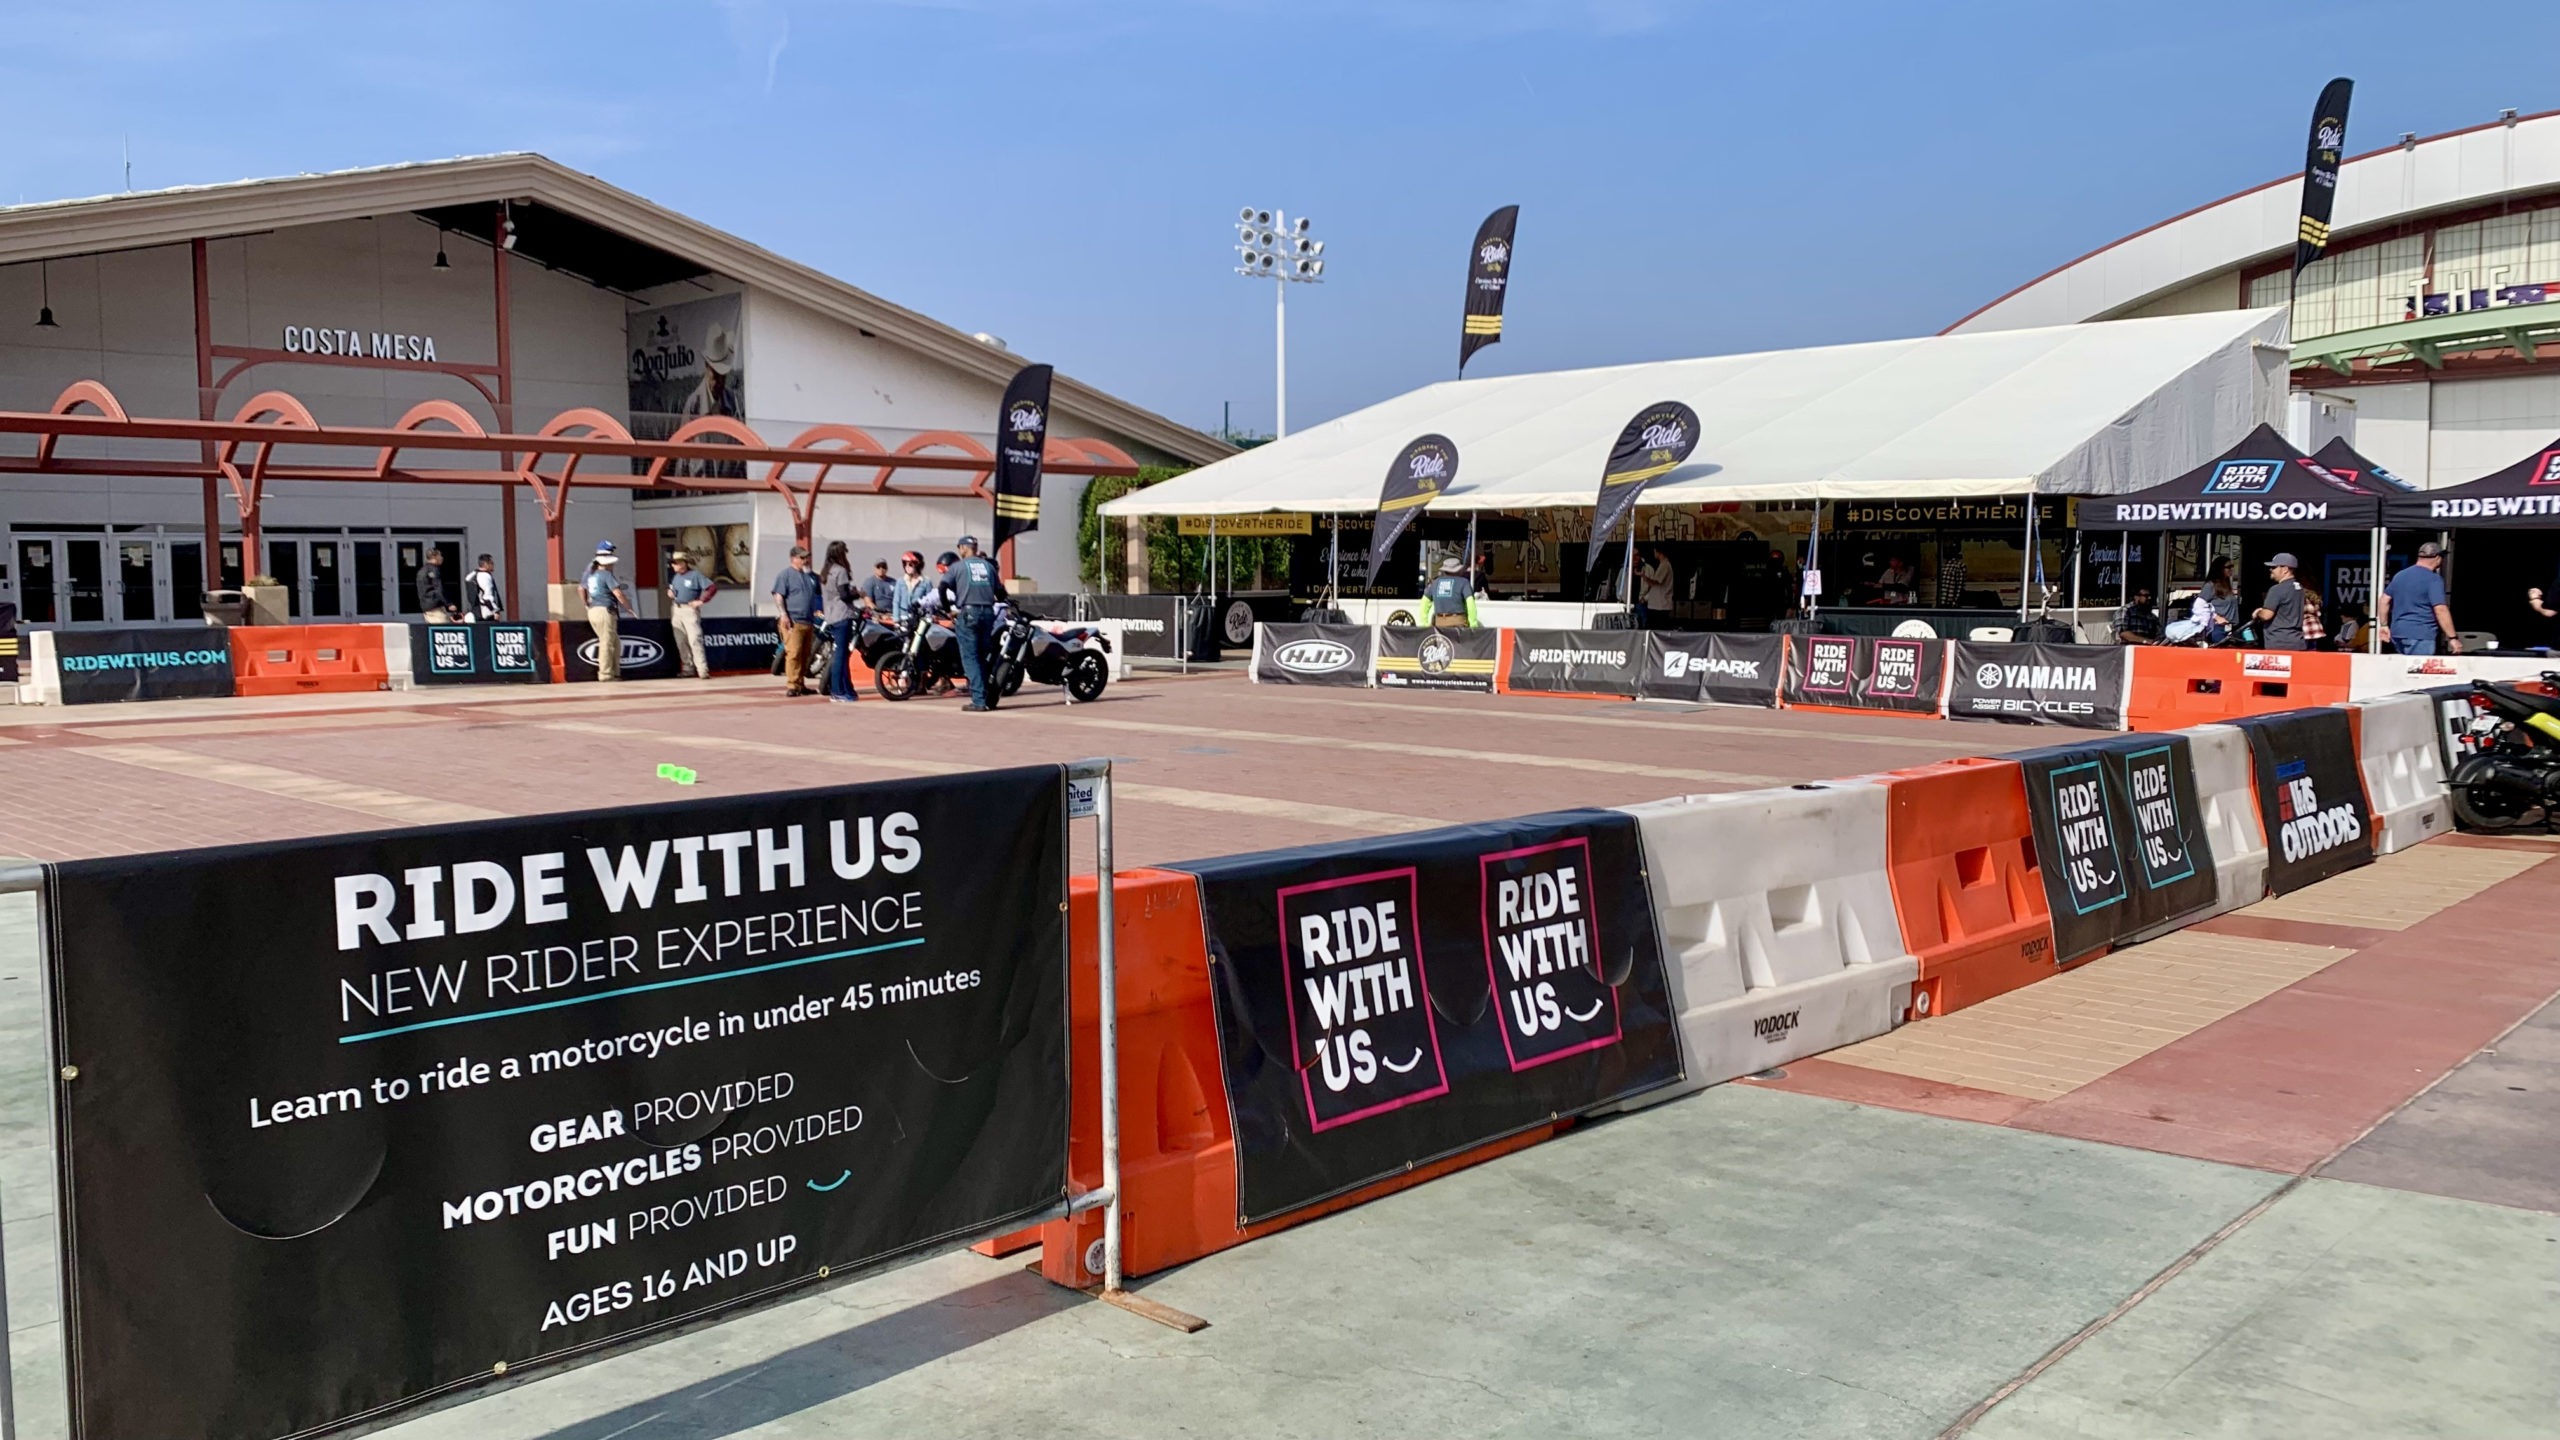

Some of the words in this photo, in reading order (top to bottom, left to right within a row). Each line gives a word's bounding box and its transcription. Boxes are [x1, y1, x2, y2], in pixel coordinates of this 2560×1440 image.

[1481, 243, 1508, 264] Ride
[2410, 265, 2509, 318] THE
[285, 325, 362, 357] COSTA
[372, 332, 436, 362] MESA
[1010, 409, 1041, 430] Ride
[1641, 421, 1682, 449] Ride
[1410, 453, 1444, 478] Ride
[2224, 465, 2269, 475] RIDE
[2215, 483, 2241, 491] US
[2221, 474, 2268, 483] WITH
[1847, 505, 2053, 523] #DISCOVERTHERIE
[2117, 502, 2328, 521] RIDEWITHUS.COM
[434, 632, 466, 644] RIDE
[434, 643, 468, 656] WITH
[495, 632, 526, 644] RIDE
[496, 643, 527, 656] WITH
[62, 650, 228, 671] RIDEWITHUS.COM
[436, 655, 455, 668] US
[498, 655, 516, 667] US
[1285, 649, 1344, 663] HJC
[1423, 643, 1448, 663] Ride
[1529, 649, 1627, 665] #RIDEWITHUS
[1814, 645, 1847, 658] RIDE
[1881, 647, 1914, 662] RIDE
[1688, 658, 1761, 679] SHARK
[1813, 659, 1847, 672] WITH
[1880, 661, 1915, 676] WITH
[2004, 665, 2097, 690] YAMAHA
[1811, 672, 1830, 685] US
[1876, 676, 1896, 690] US
[2004, 700, 2094, 714] BICYCLES
[2133, 764, 2168, 800] RIDE
[2059, 781, 2099, 820] RIDE
[2137, 797, 2175, 834] WITH
[2062, 816, 2108, 856] WITH
[2281, 803, 2361, 863] OUTDOORS
[2145, 836, 2169, 868] US
[334, 851, 569, 951] RIDE
[586, 823, 805, 912] WITH
[829, 811, 922, 879] US
[2071, 857, 2098, 892] US
[1499, 867, 1580, 927] RIDE
[1300, 901, 1400, 969] RIDE
[340, 960, 467, 1021] NEW
[487, 935, 640, 998] RIDER
[657, 893, 923, 970] EXPERIENCE
[1498, 919, 1589, 982] WITH
[1304, 958, 1413, 1030] WITH
[1510, 982, 1561, 1036] US
[1754, 1010, 1799, 1038] YODOCK
[251, 1085, 362, 1127] Learn
[371, 1074, 410, 1105] to
[420, 1054, 490, 1094] ride
[499, 1056, 521, 1079] a
[529, 1013, 710, 1073] motorcycle
[718, 1008, 745, 1036] in
[752, 992, 833, 1031] under
[840, 983, 874, 1013] 45
[881, 964, 981, 1004] minutes
[1315, 1029, 1377, 1091] US
[529, 1109, 626, 1153] GEAR
[633, 1071, 794, 1130] PROVIDED
[442, 1143, 702, 1229] MOTORCYCLES
[711, 1105, 863, 1164] PROVIDED
[548, 1217, 618, 1260] FUN
[628, 1174, 787, 1239] PROVIDED
[541, 1280, 634, 1331] AGES
[642, 1269, 676, 1302] 16
[682, 1246, 748, 1290] AND
[757, 1233, 797, 1264] UP
